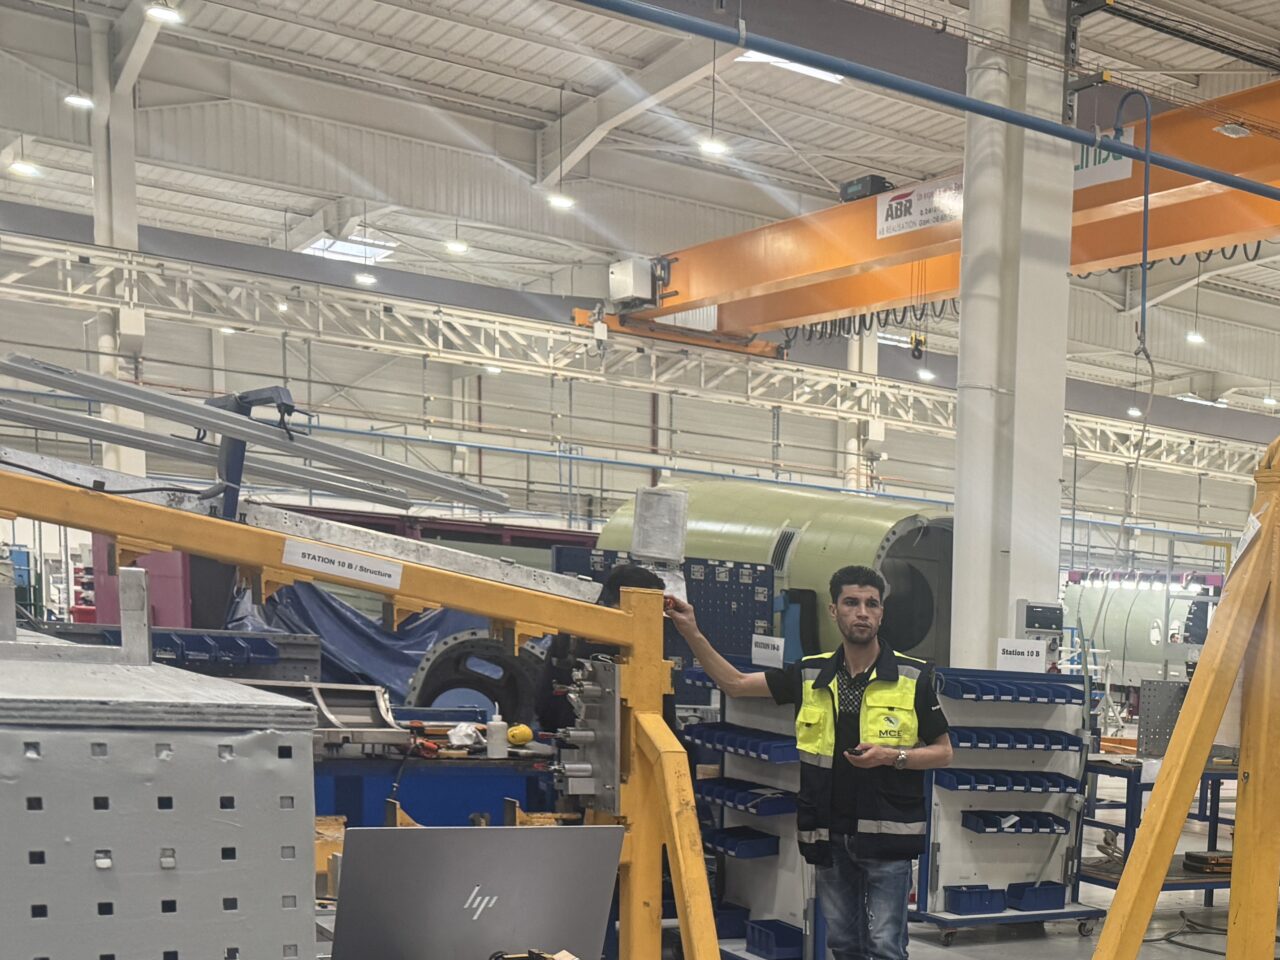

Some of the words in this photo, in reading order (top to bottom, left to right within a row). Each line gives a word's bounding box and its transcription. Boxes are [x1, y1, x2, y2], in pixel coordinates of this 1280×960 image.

[885, 199, 913, 222] ABR
[301, 551, 335, 566] STATION
[347, 562, 353, 570] B
[359, 566, 392, 579] Structure
[1001, 648, 1025, 657] Station
